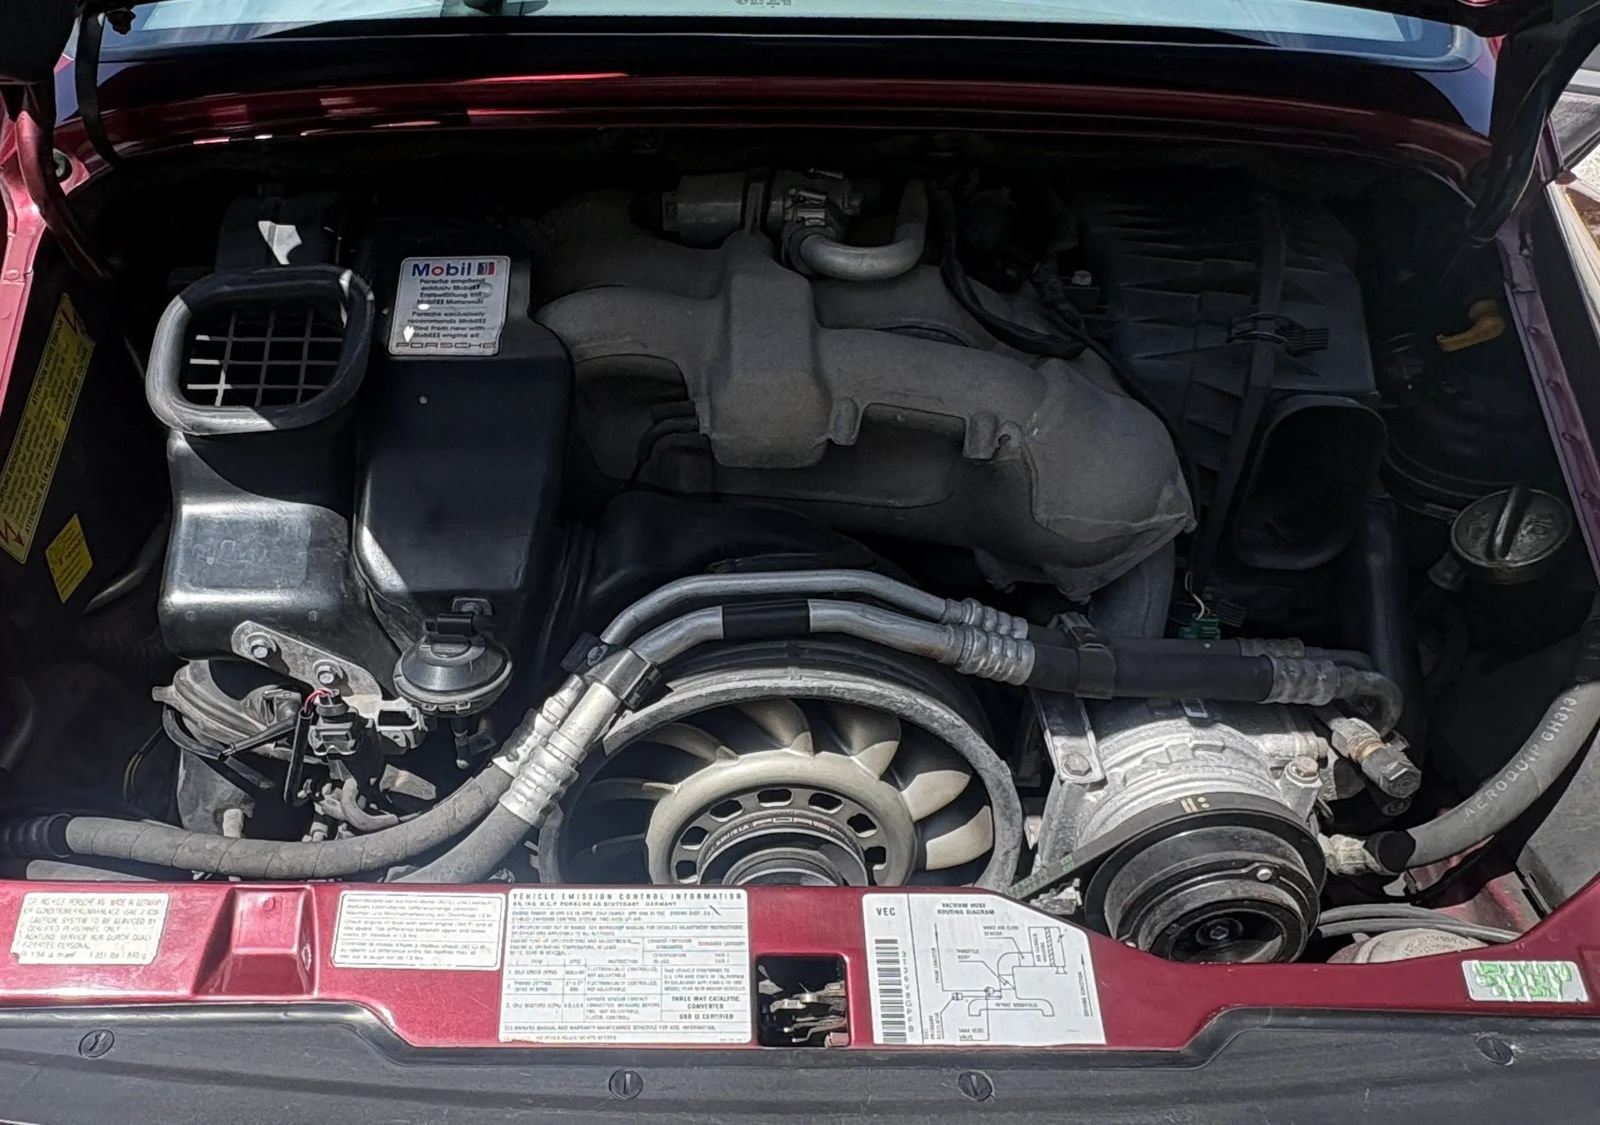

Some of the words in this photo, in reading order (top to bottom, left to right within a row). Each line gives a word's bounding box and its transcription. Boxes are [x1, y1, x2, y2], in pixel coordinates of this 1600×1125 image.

[412, 262, 472, 276] Mobil
[1464, 743, 1540, 818] AEROQUIP
[876, 907, 896, 916] VEC
